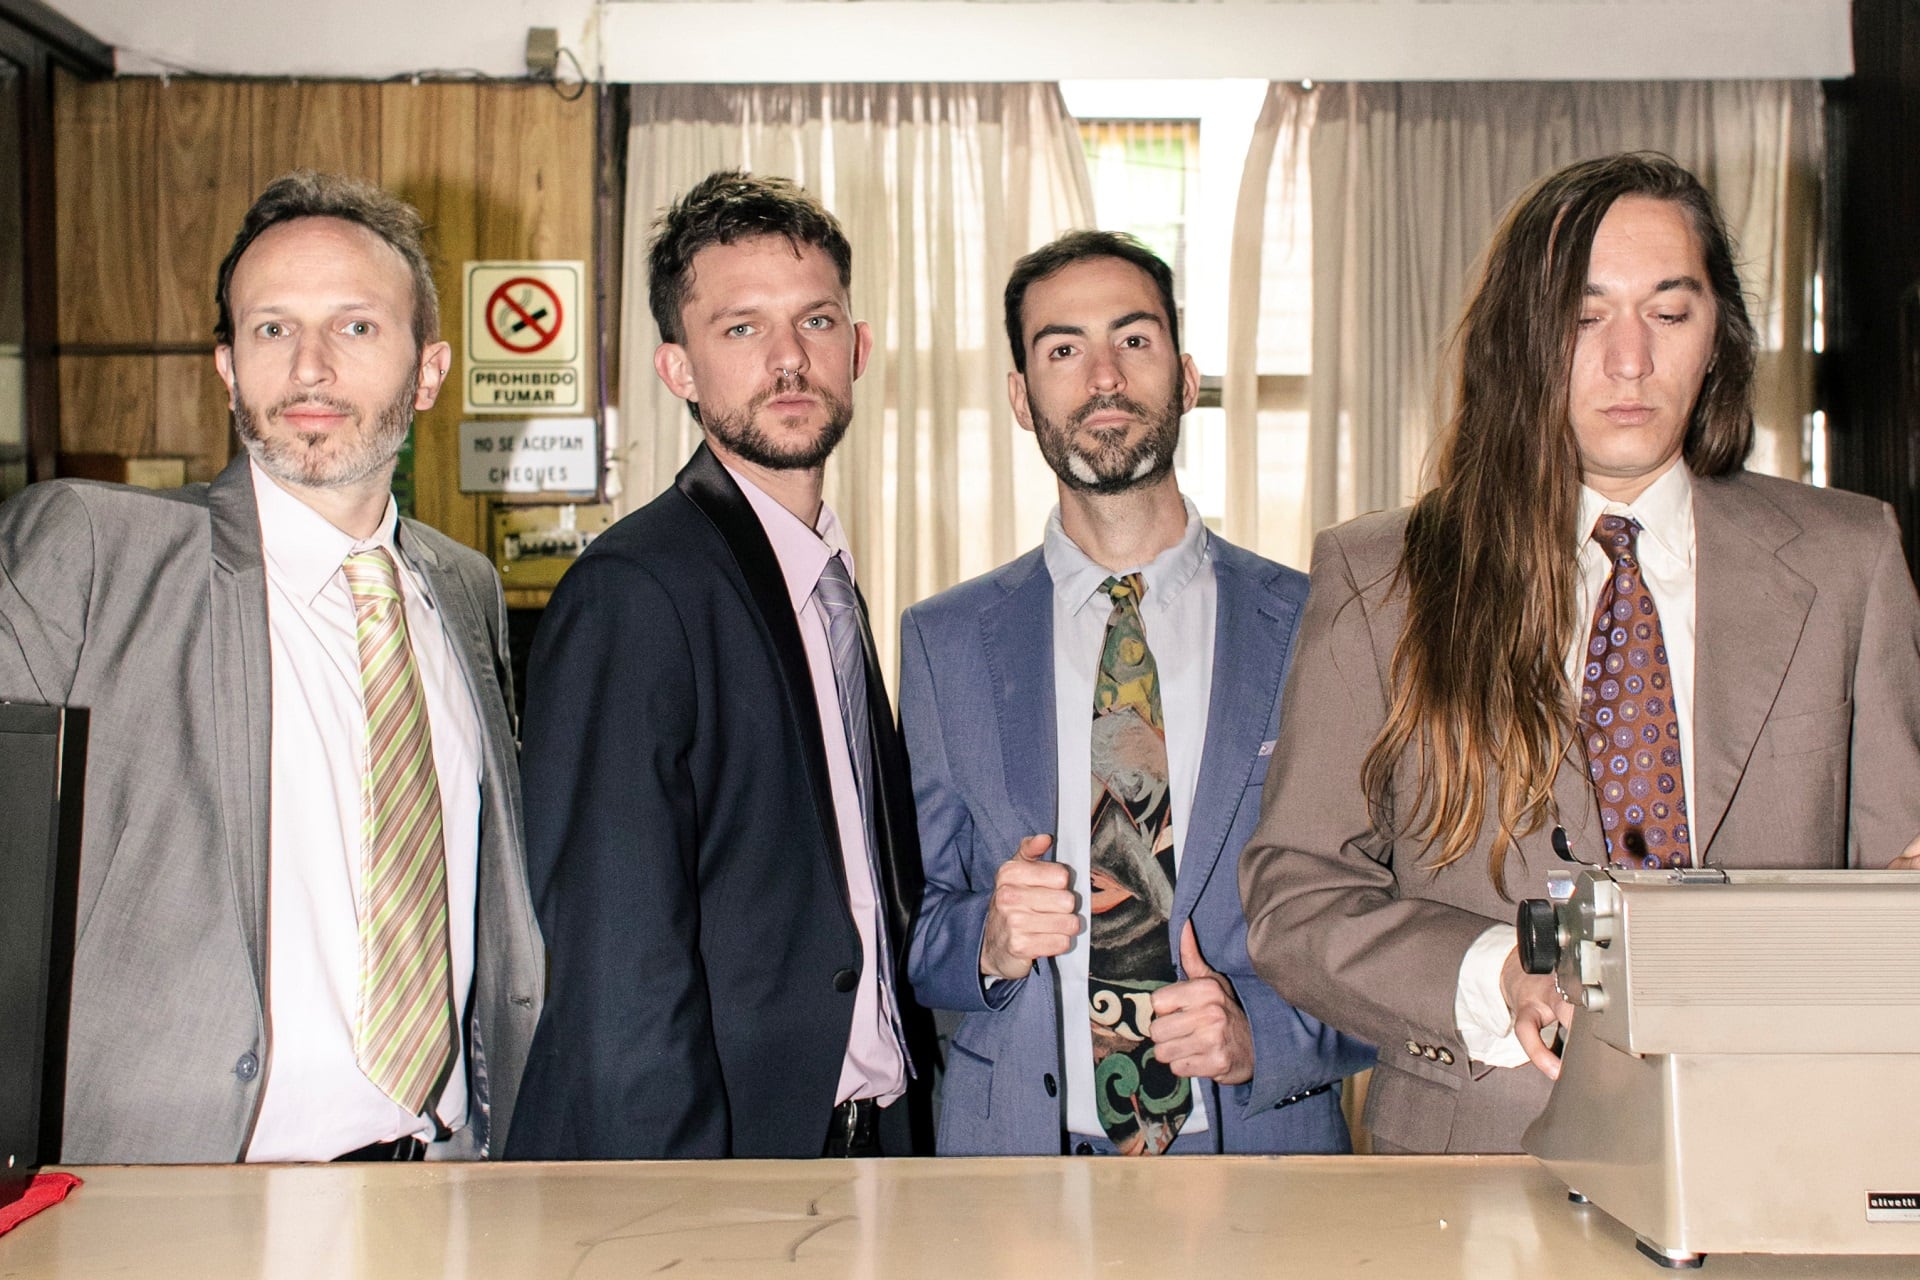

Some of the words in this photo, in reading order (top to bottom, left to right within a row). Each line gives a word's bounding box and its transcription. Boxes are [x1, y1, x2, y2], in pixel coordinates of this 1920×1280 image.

[475, 373, 573, 385] PROHIBIDO
[494, 390, 555, 402] FUMAR
[474, 437, 493, 452] NO
[498, 436, 514, 451] SE
[488, 467, 567, 483] CHEQUES
[1871, 1198, 1916, 1207] olivetti
